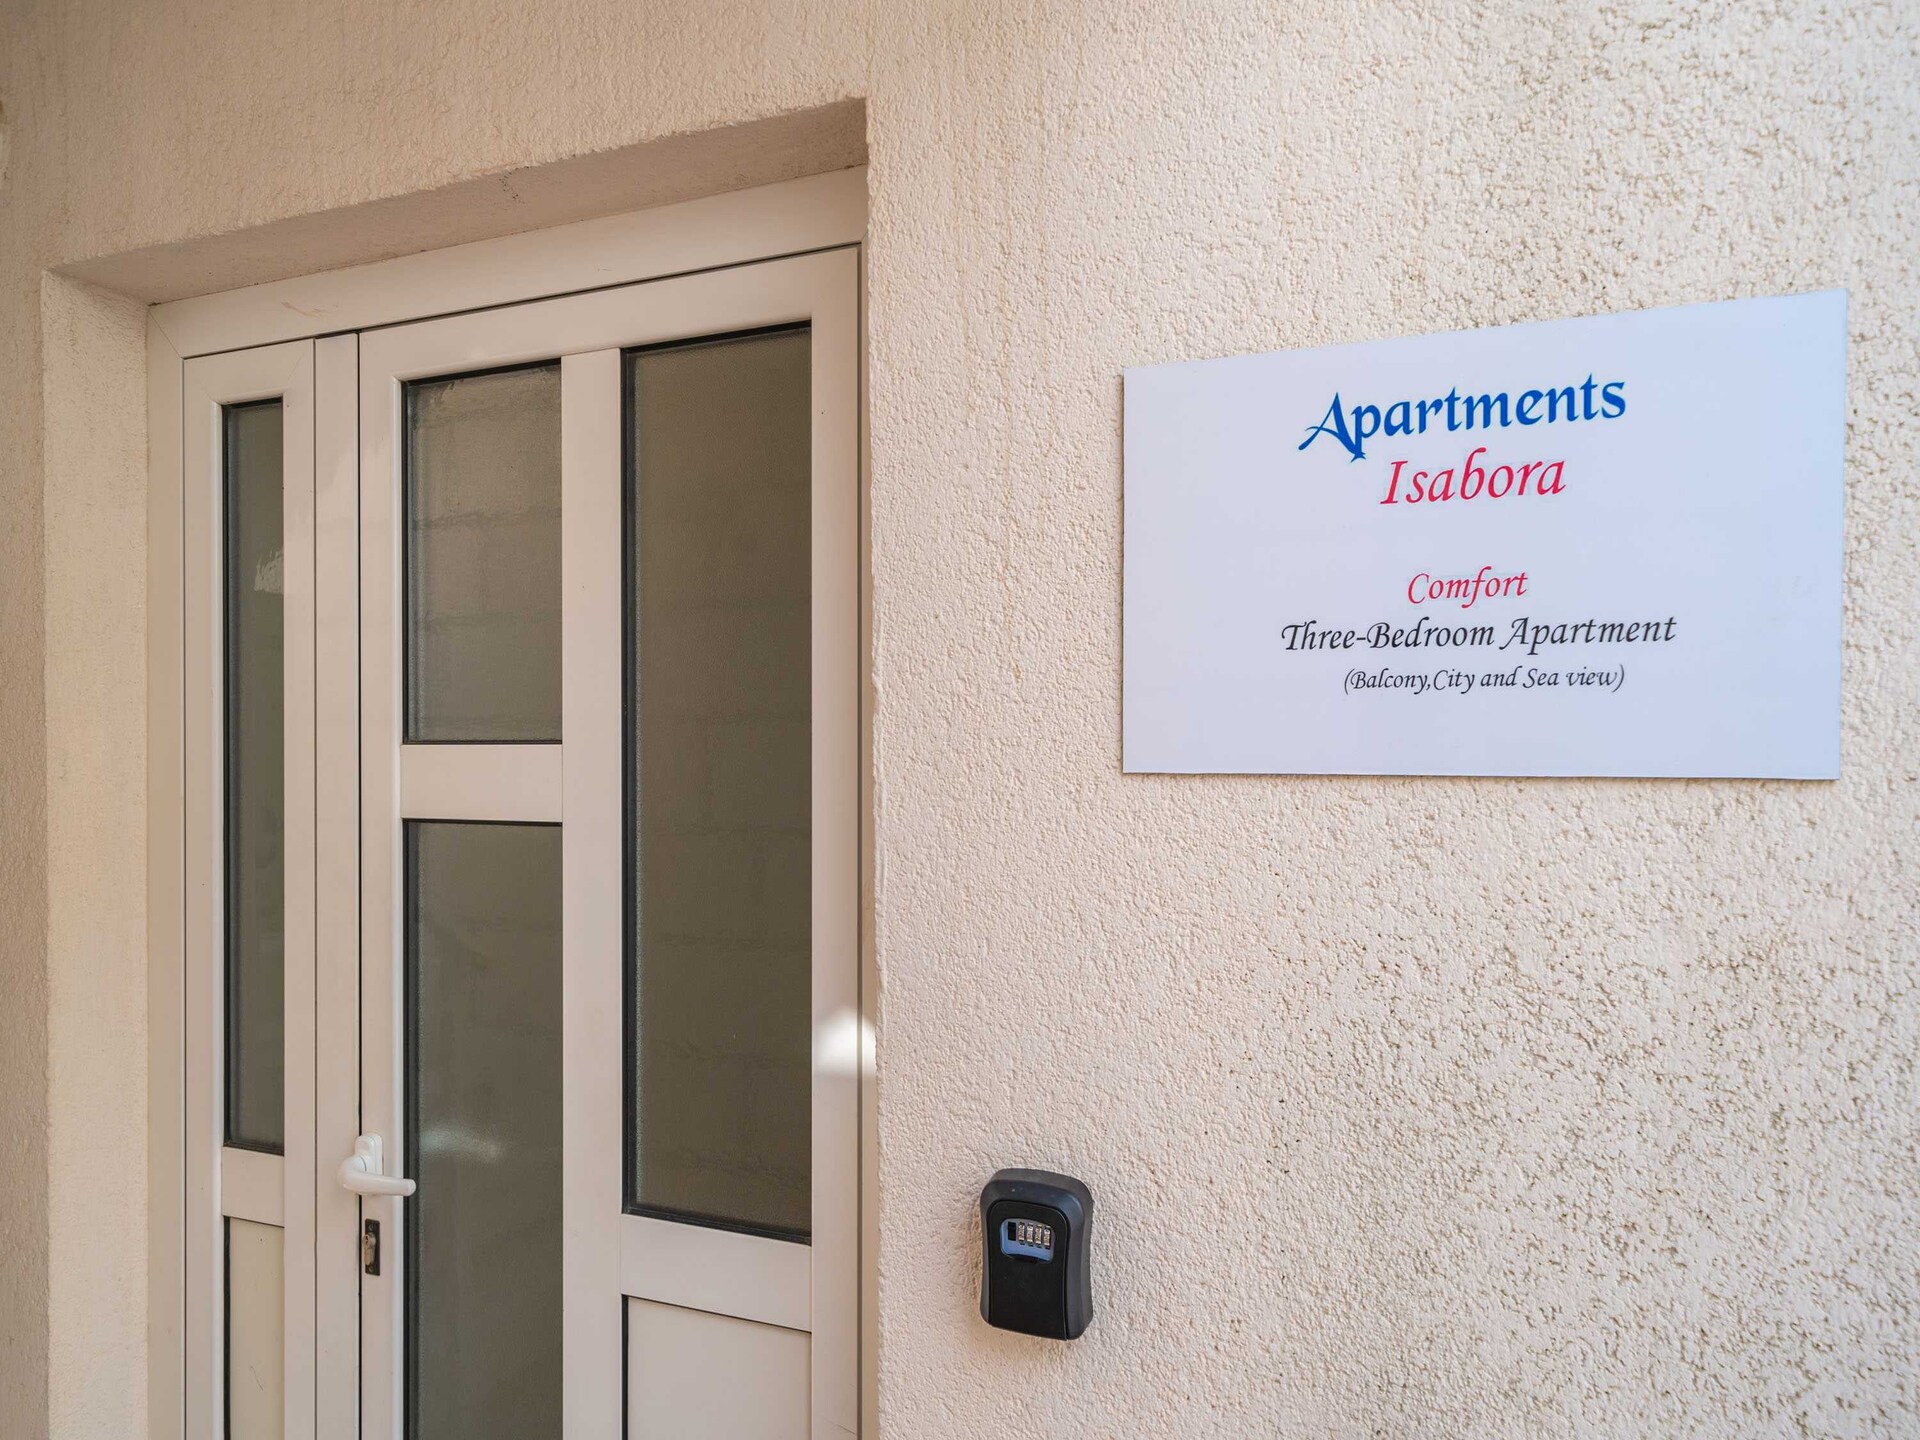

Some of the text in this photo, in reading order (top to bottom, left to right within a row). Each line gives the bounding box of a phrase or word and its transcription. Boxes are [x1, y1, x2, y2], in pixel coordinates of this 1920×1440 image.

[1298, 373, 1627, 464] Apartments
[1379, 446, 1567, 505] Isabora
[1406, 565, 1529, 609] Comfort
[1281, 615, 1678, 656] Three-Bedroom Apartment
[1480, 665, 1524, 688] and
[1522, 667, 1560, 689] Sea
[1565, 664, 1625, 693] view)
